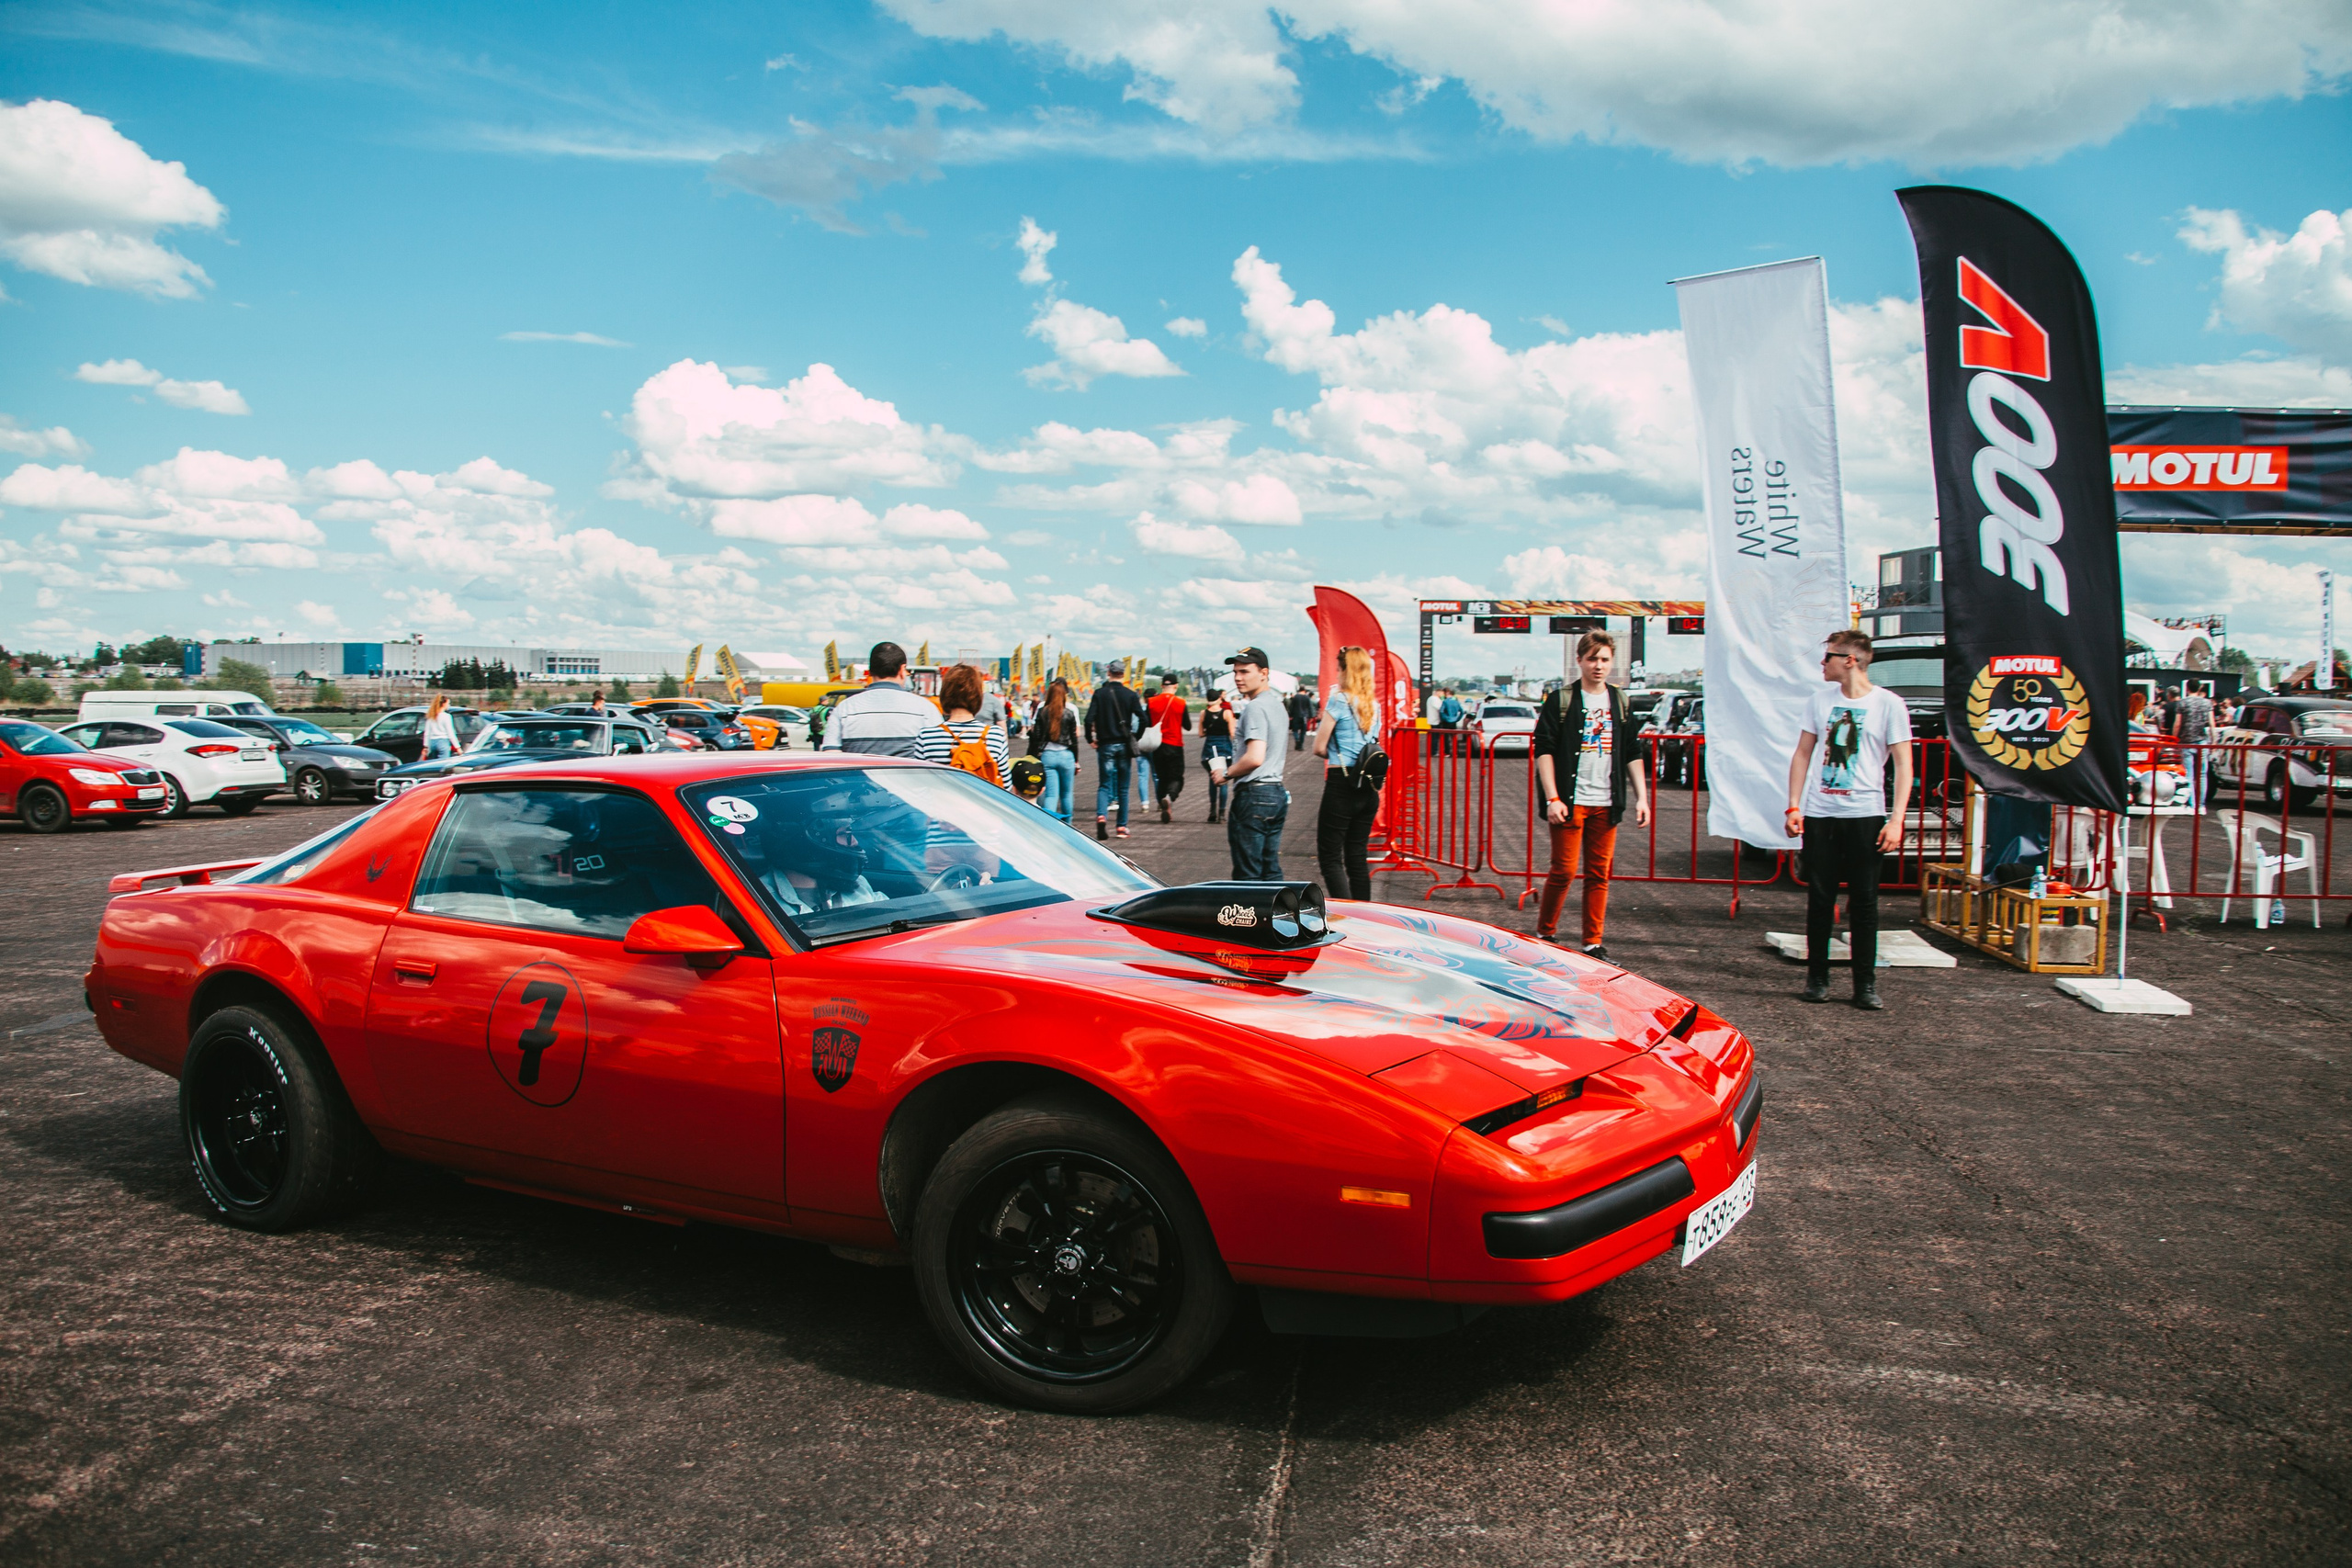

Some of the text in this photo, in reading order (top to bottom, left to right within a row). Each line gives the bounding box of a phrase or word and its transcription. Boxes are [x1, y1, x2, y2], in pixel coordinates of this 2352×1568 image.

[1957, 256, 2069, 615] 300V
[2111, 452, 2279, 485] MOTUL
[1420, 602, 1459, 610] MOTUL
[1682, 618, 1704, 629] 02
[1994, 658, 2058, 673] MOTUL
[2012, 679, 2042, 703] 50
[1978, 706, 2083, 732] 300V
[720, 801, 737, 812] 7
[573, 854, 605, 871] 20
[518, 980, 568, 1086] 7
